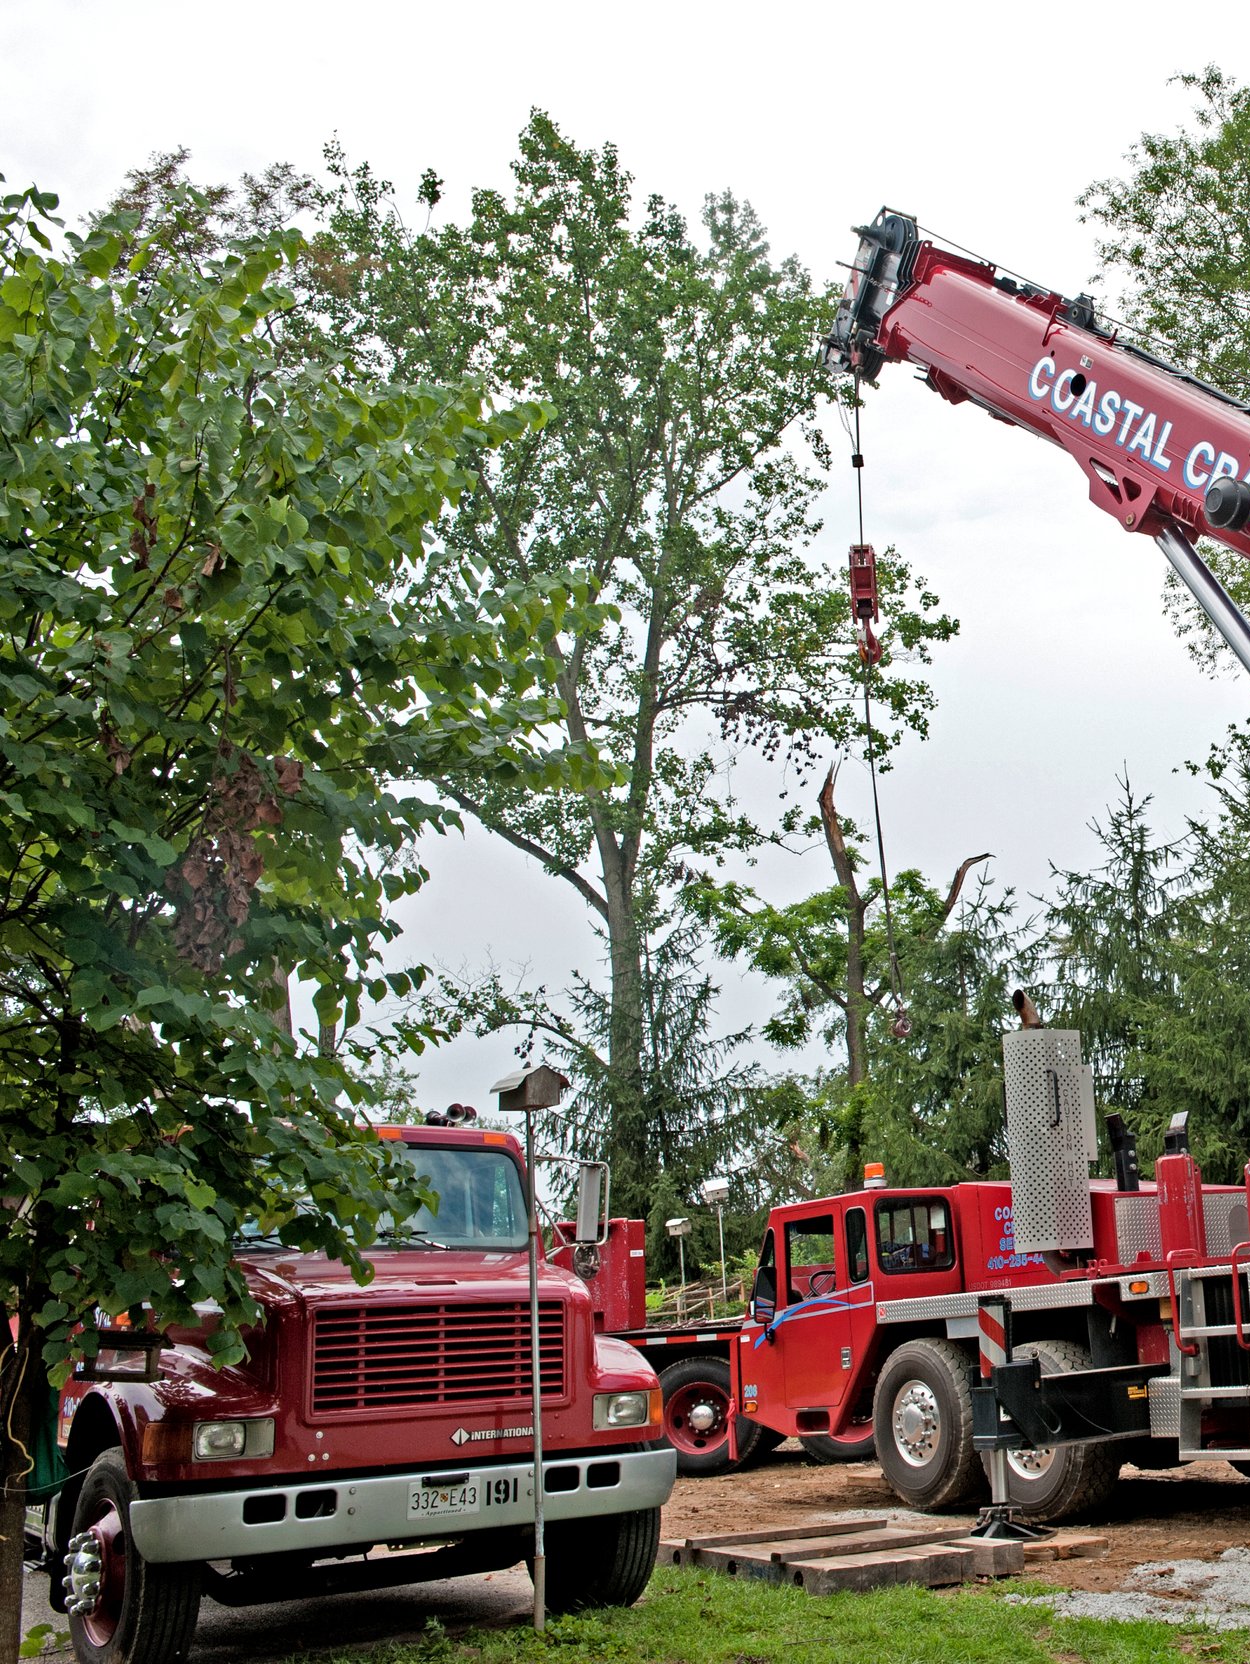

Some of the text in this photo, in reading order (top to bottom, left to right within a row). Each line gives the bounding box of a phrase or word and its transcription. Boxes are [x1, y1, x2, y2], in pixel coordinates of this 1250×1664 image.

[1028, 356, 1173, 472] COASTAL
[1062, 1088, 1075, 1187] CAUTION HOT
[471, 1426, 534, 1441] INTERNATIONA
[411, 1487, 477, 1510] 332 E43
[486, 1478, 518, 1506] 191
